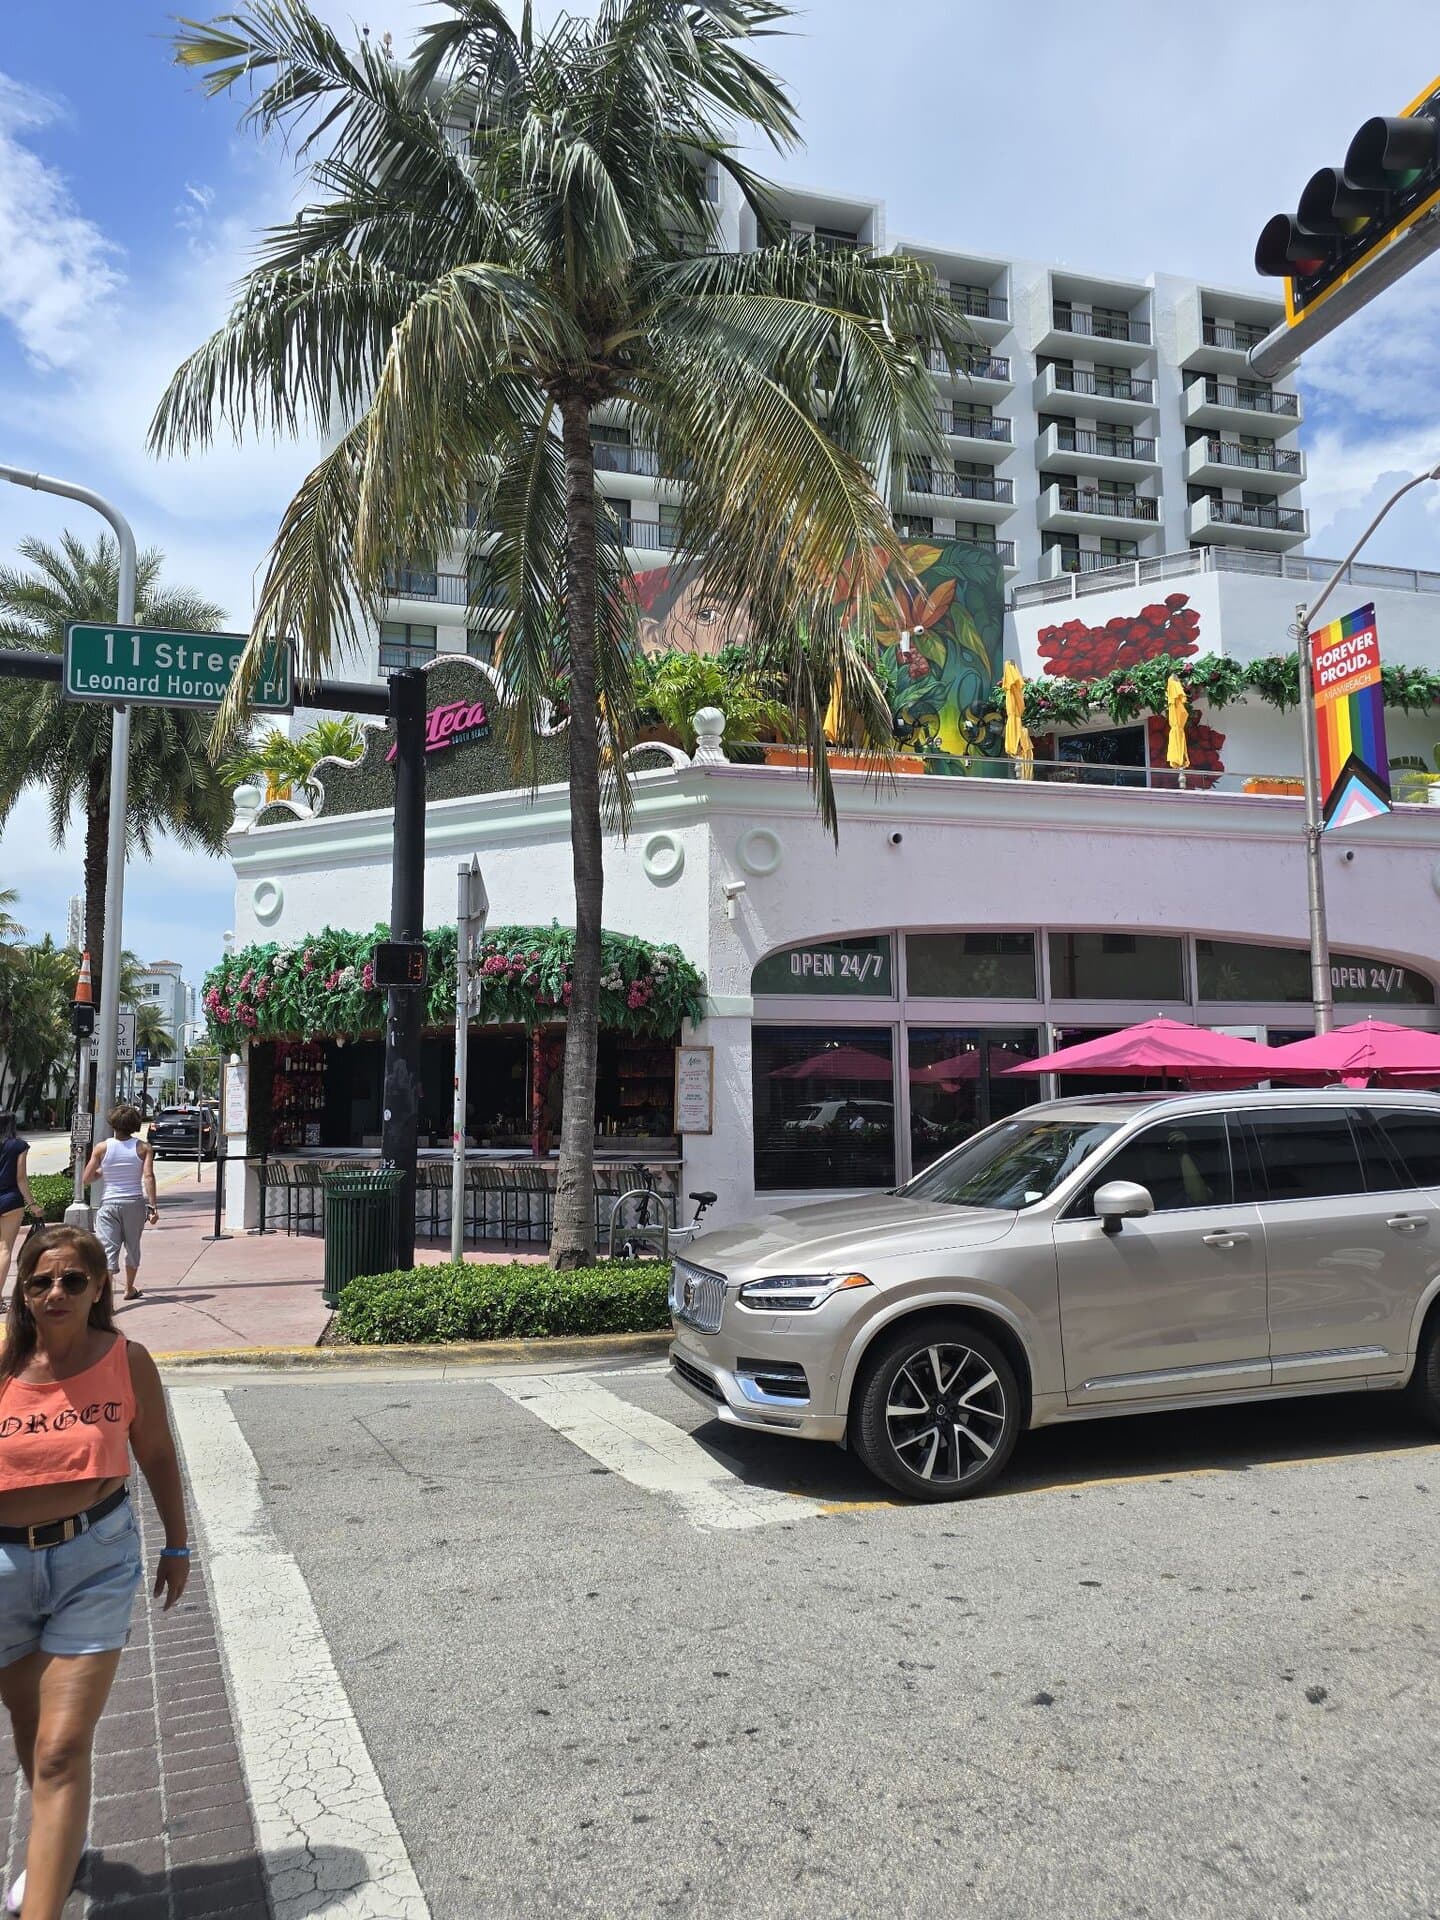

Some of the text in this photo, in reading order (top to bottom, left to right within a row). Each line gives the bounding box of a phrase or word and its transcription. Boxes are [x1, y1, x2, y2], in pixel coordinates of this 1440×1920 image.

[154, 643, 243, 673] Stree
[1316, 631, 1374, 671] FOREVER
[1320, 652, 1372, 686] PROUD.
[76, 669, 159, 693] Leonard
[168, 675, 255, 701] Horowz
[790, 953, 884, 982] OPEN 24/7
[1331, 967, 1404, 992] OPEN 24/7
